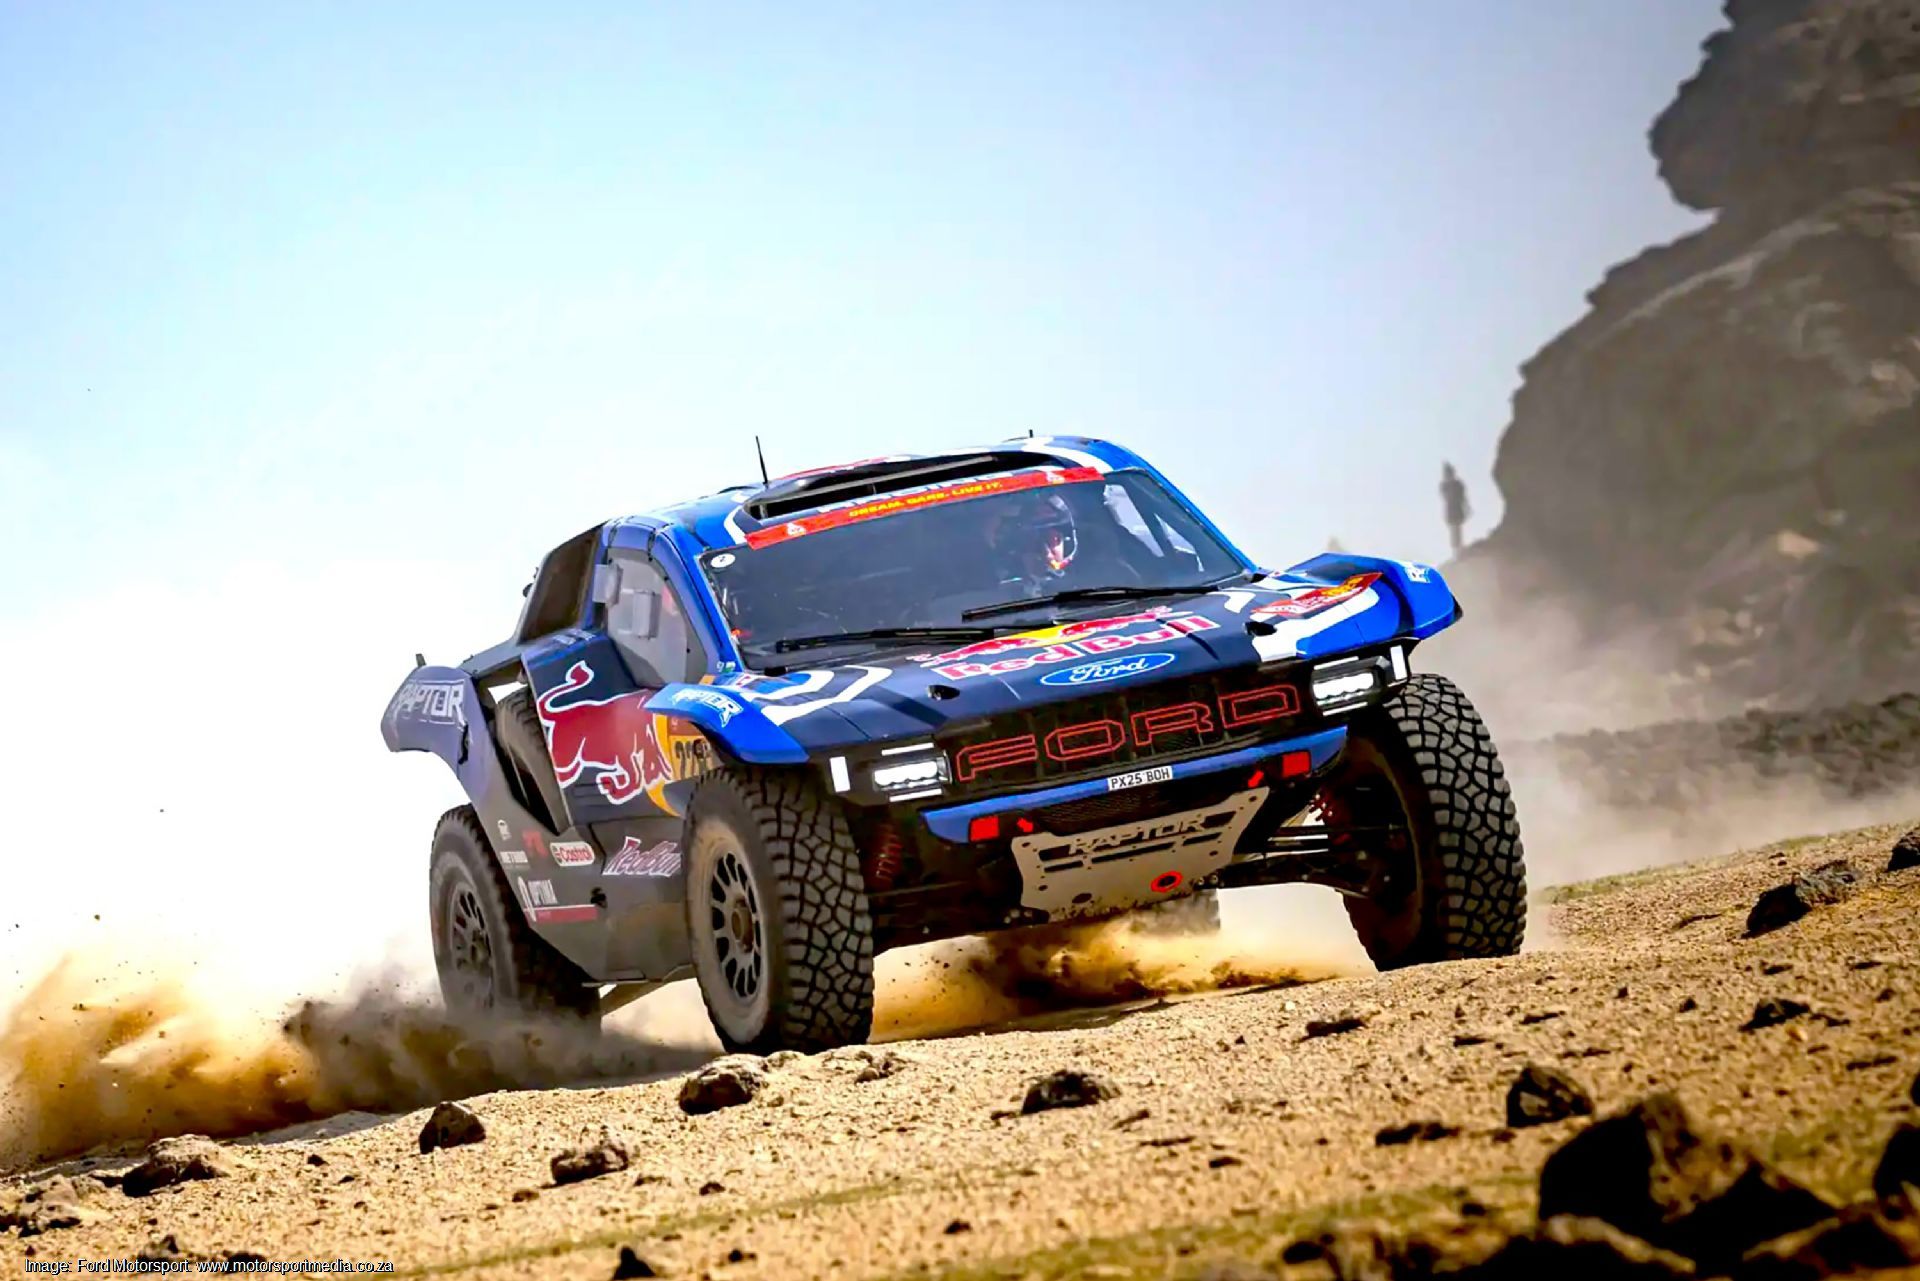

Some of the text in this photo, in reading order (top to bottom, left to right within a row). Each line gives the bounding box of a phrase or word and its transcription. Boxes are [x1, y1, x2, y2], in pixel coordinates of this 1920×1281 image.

[1069, 657, 1149, 682] Ford
[956, 685, 1301, 782] FORD
[1111, 767, 1170, 789] PX25 BOH
[1068, 817, 1206, 856] RAPTOR
